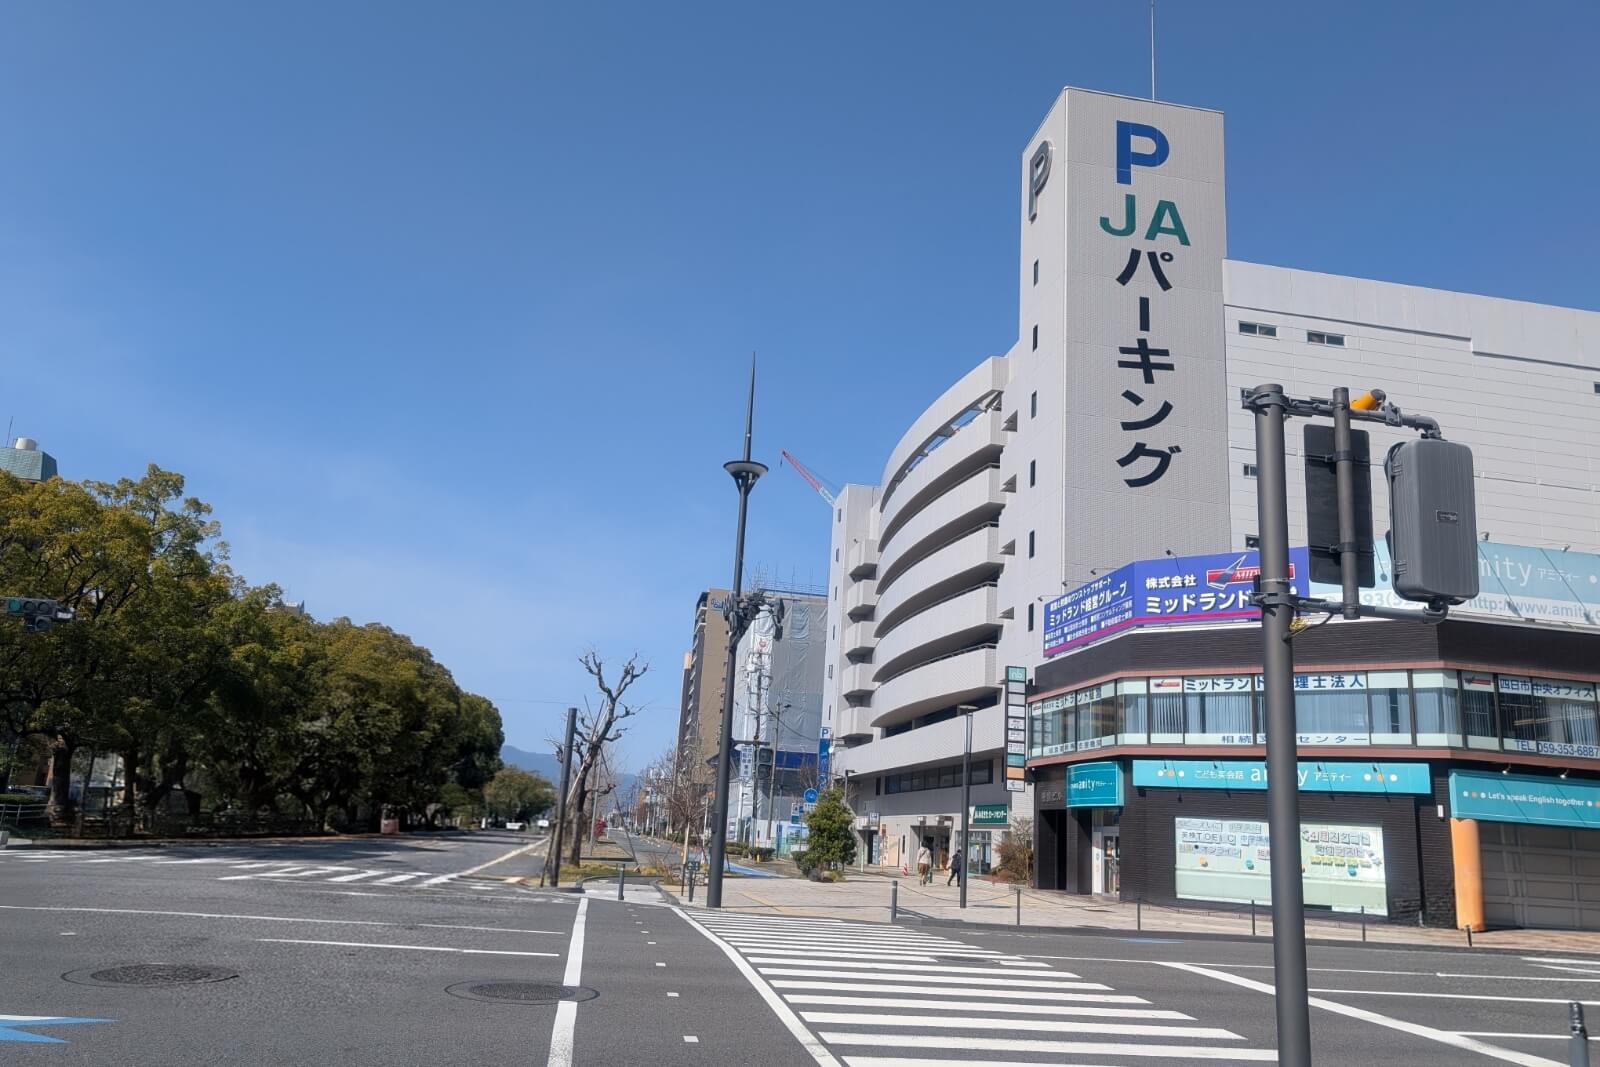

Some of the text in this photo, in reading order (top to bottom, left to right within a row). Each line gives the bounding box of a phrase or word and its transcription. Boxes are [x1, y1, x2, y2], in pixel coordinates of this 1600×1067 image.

[1115, 119, 1170, 185] P
[1028, 140, 1054, 223] P
[1099, 193, 1191, 247] JA
[1115, 248, 1183, 488] パーキング
[1478, 554, 1532, 587] mity
[1145, 574, 1197, 591] 株式会社
[1145, 589, 1252, 614] ミッドランド
[1185, 674, 1364, 691] ミッドランド理士法人
[1499, 679, 1593, 698] 四日市中央オフィス
[822, 728, 829, 738] P
[1194, 769, 1244, 780] こども英会話
[1313, 771, 1351, 783] アミティー
[1488, 791, 1585, 807] Let's speak English together
